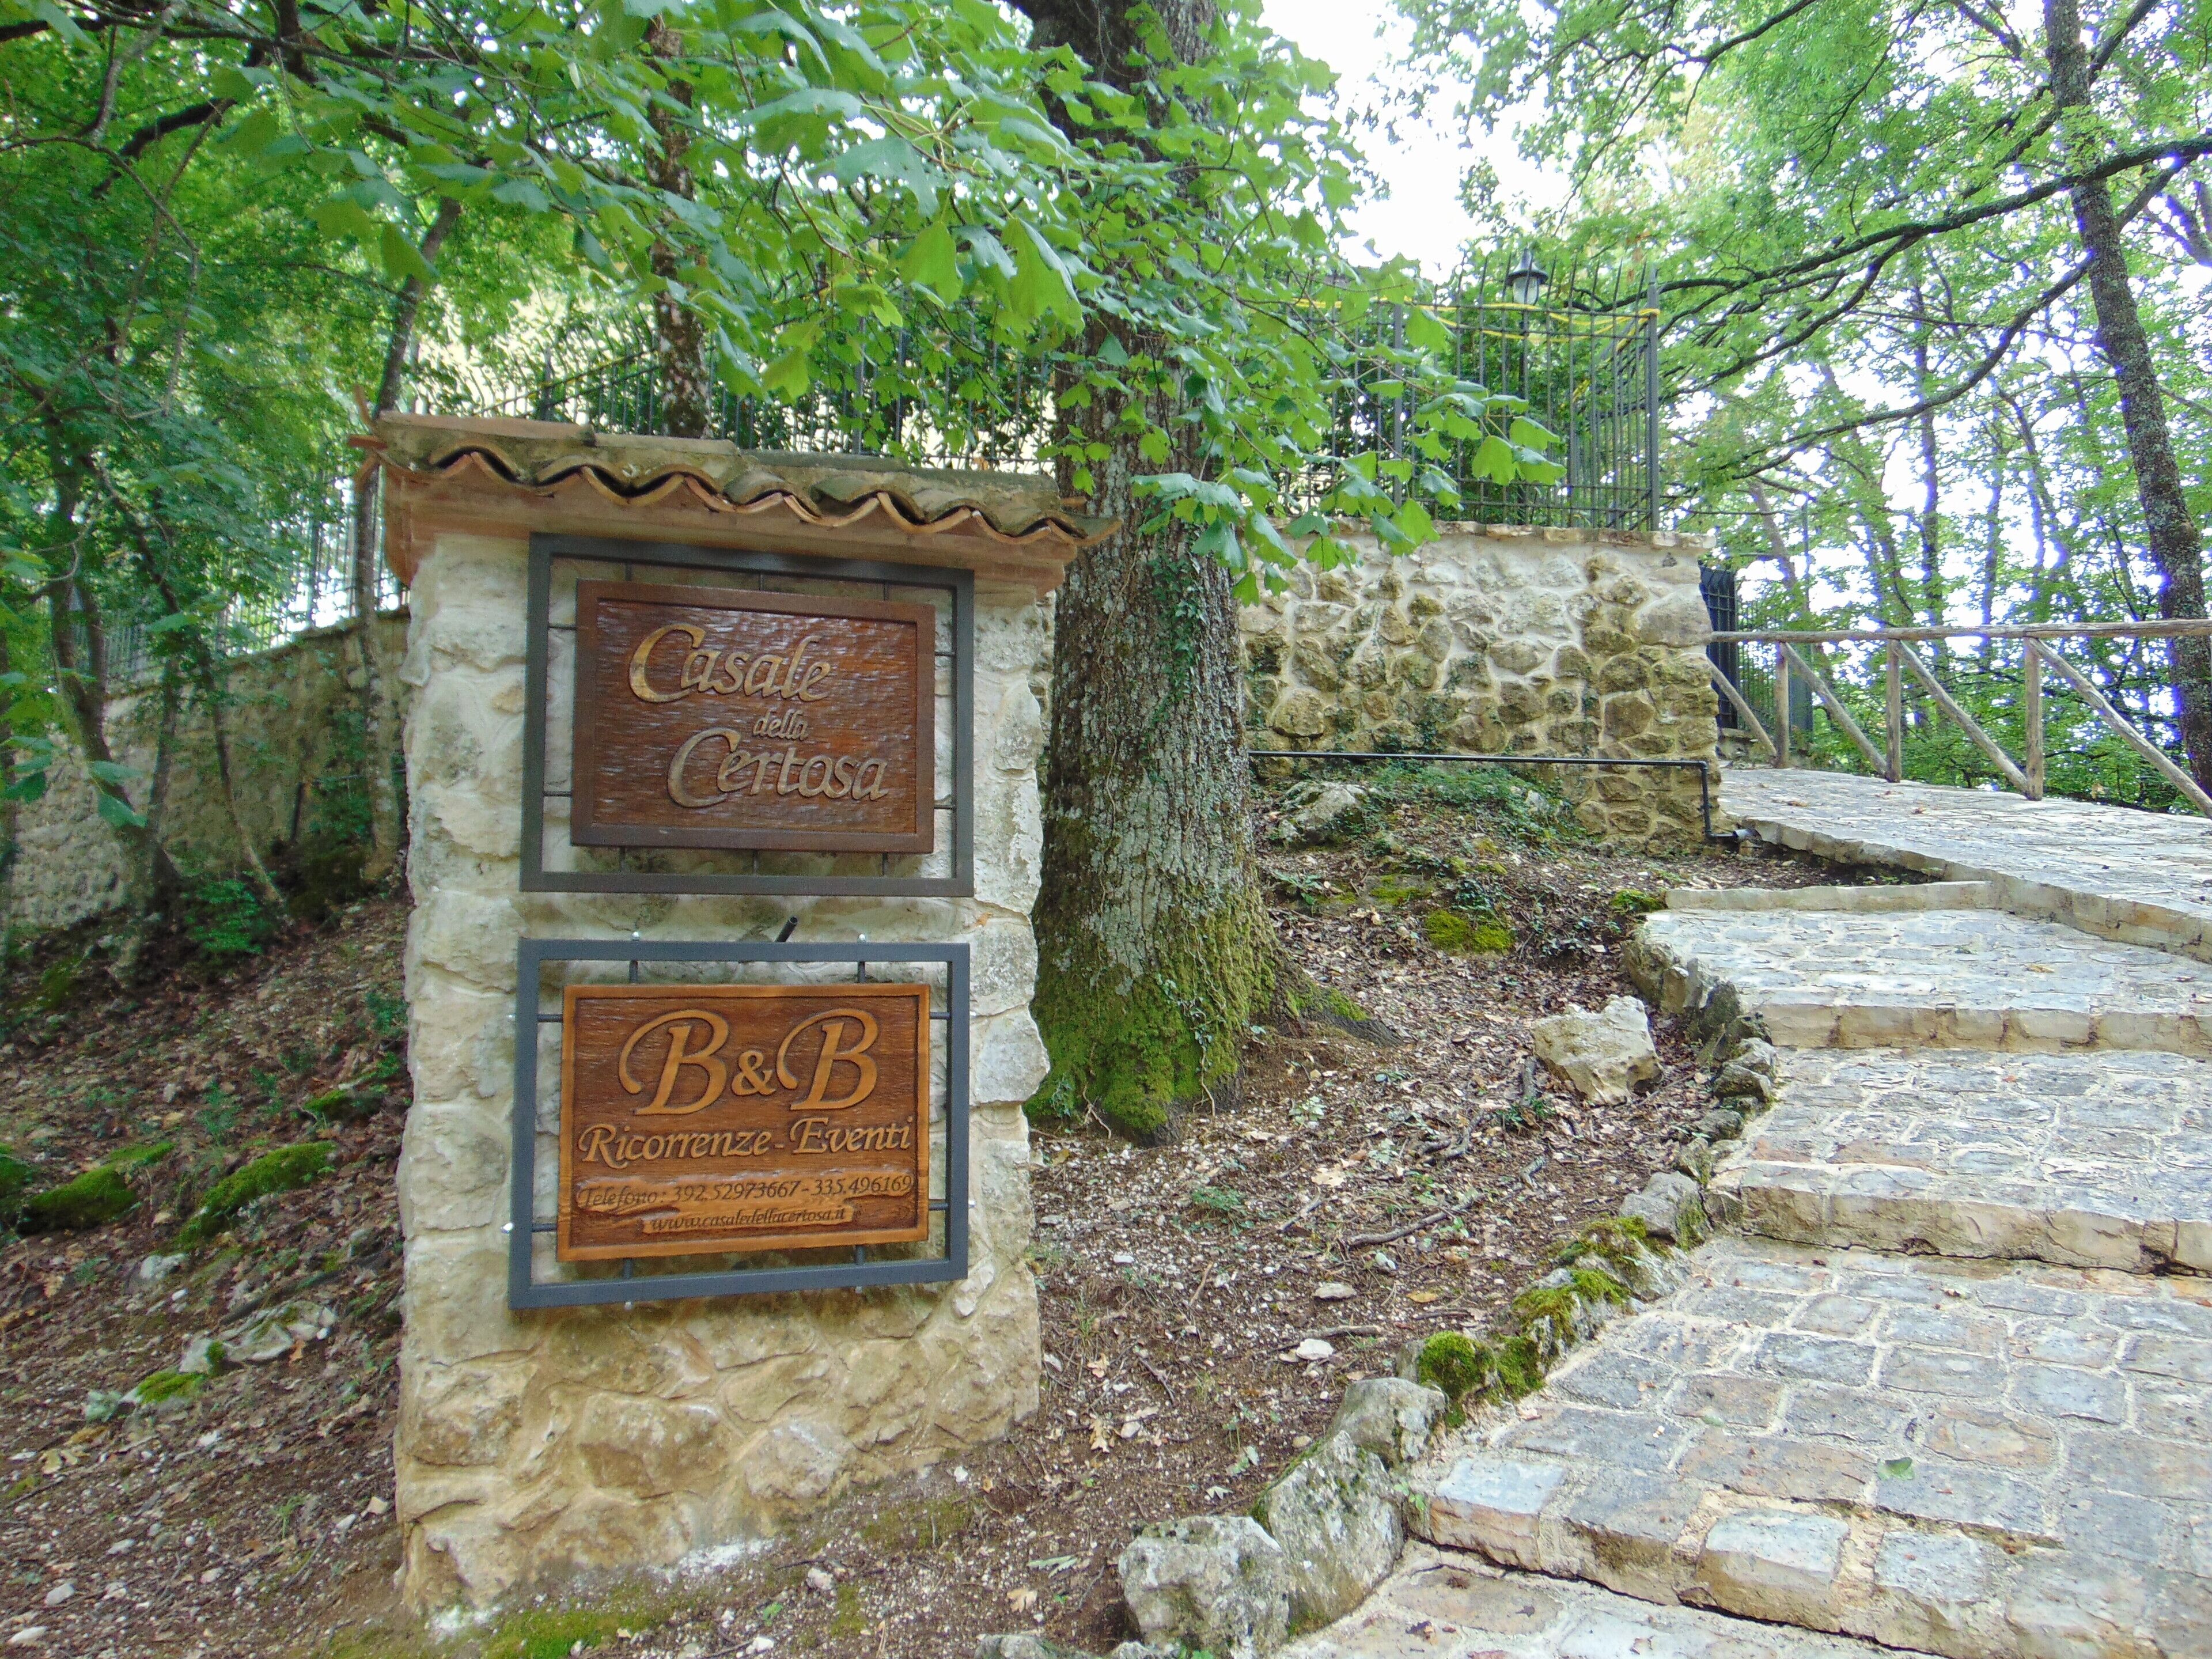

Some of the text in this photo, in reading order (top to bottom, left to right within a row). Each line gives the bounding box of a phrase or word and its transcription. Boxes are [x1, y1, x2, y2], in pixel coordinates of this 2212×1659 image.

[629, 623, 832, 703] Casale
[752, 709, 809, 740] della
[668, 727, 889, 807] Certosa
[578, 1123, 770, 1169] Ricorrenze
[790, 1116, 913, 1154] Eventi
[578, 1184, 666, 1210] Telefono:
[650, 1204, 846, 1231] www.casaledellacertosa.it
